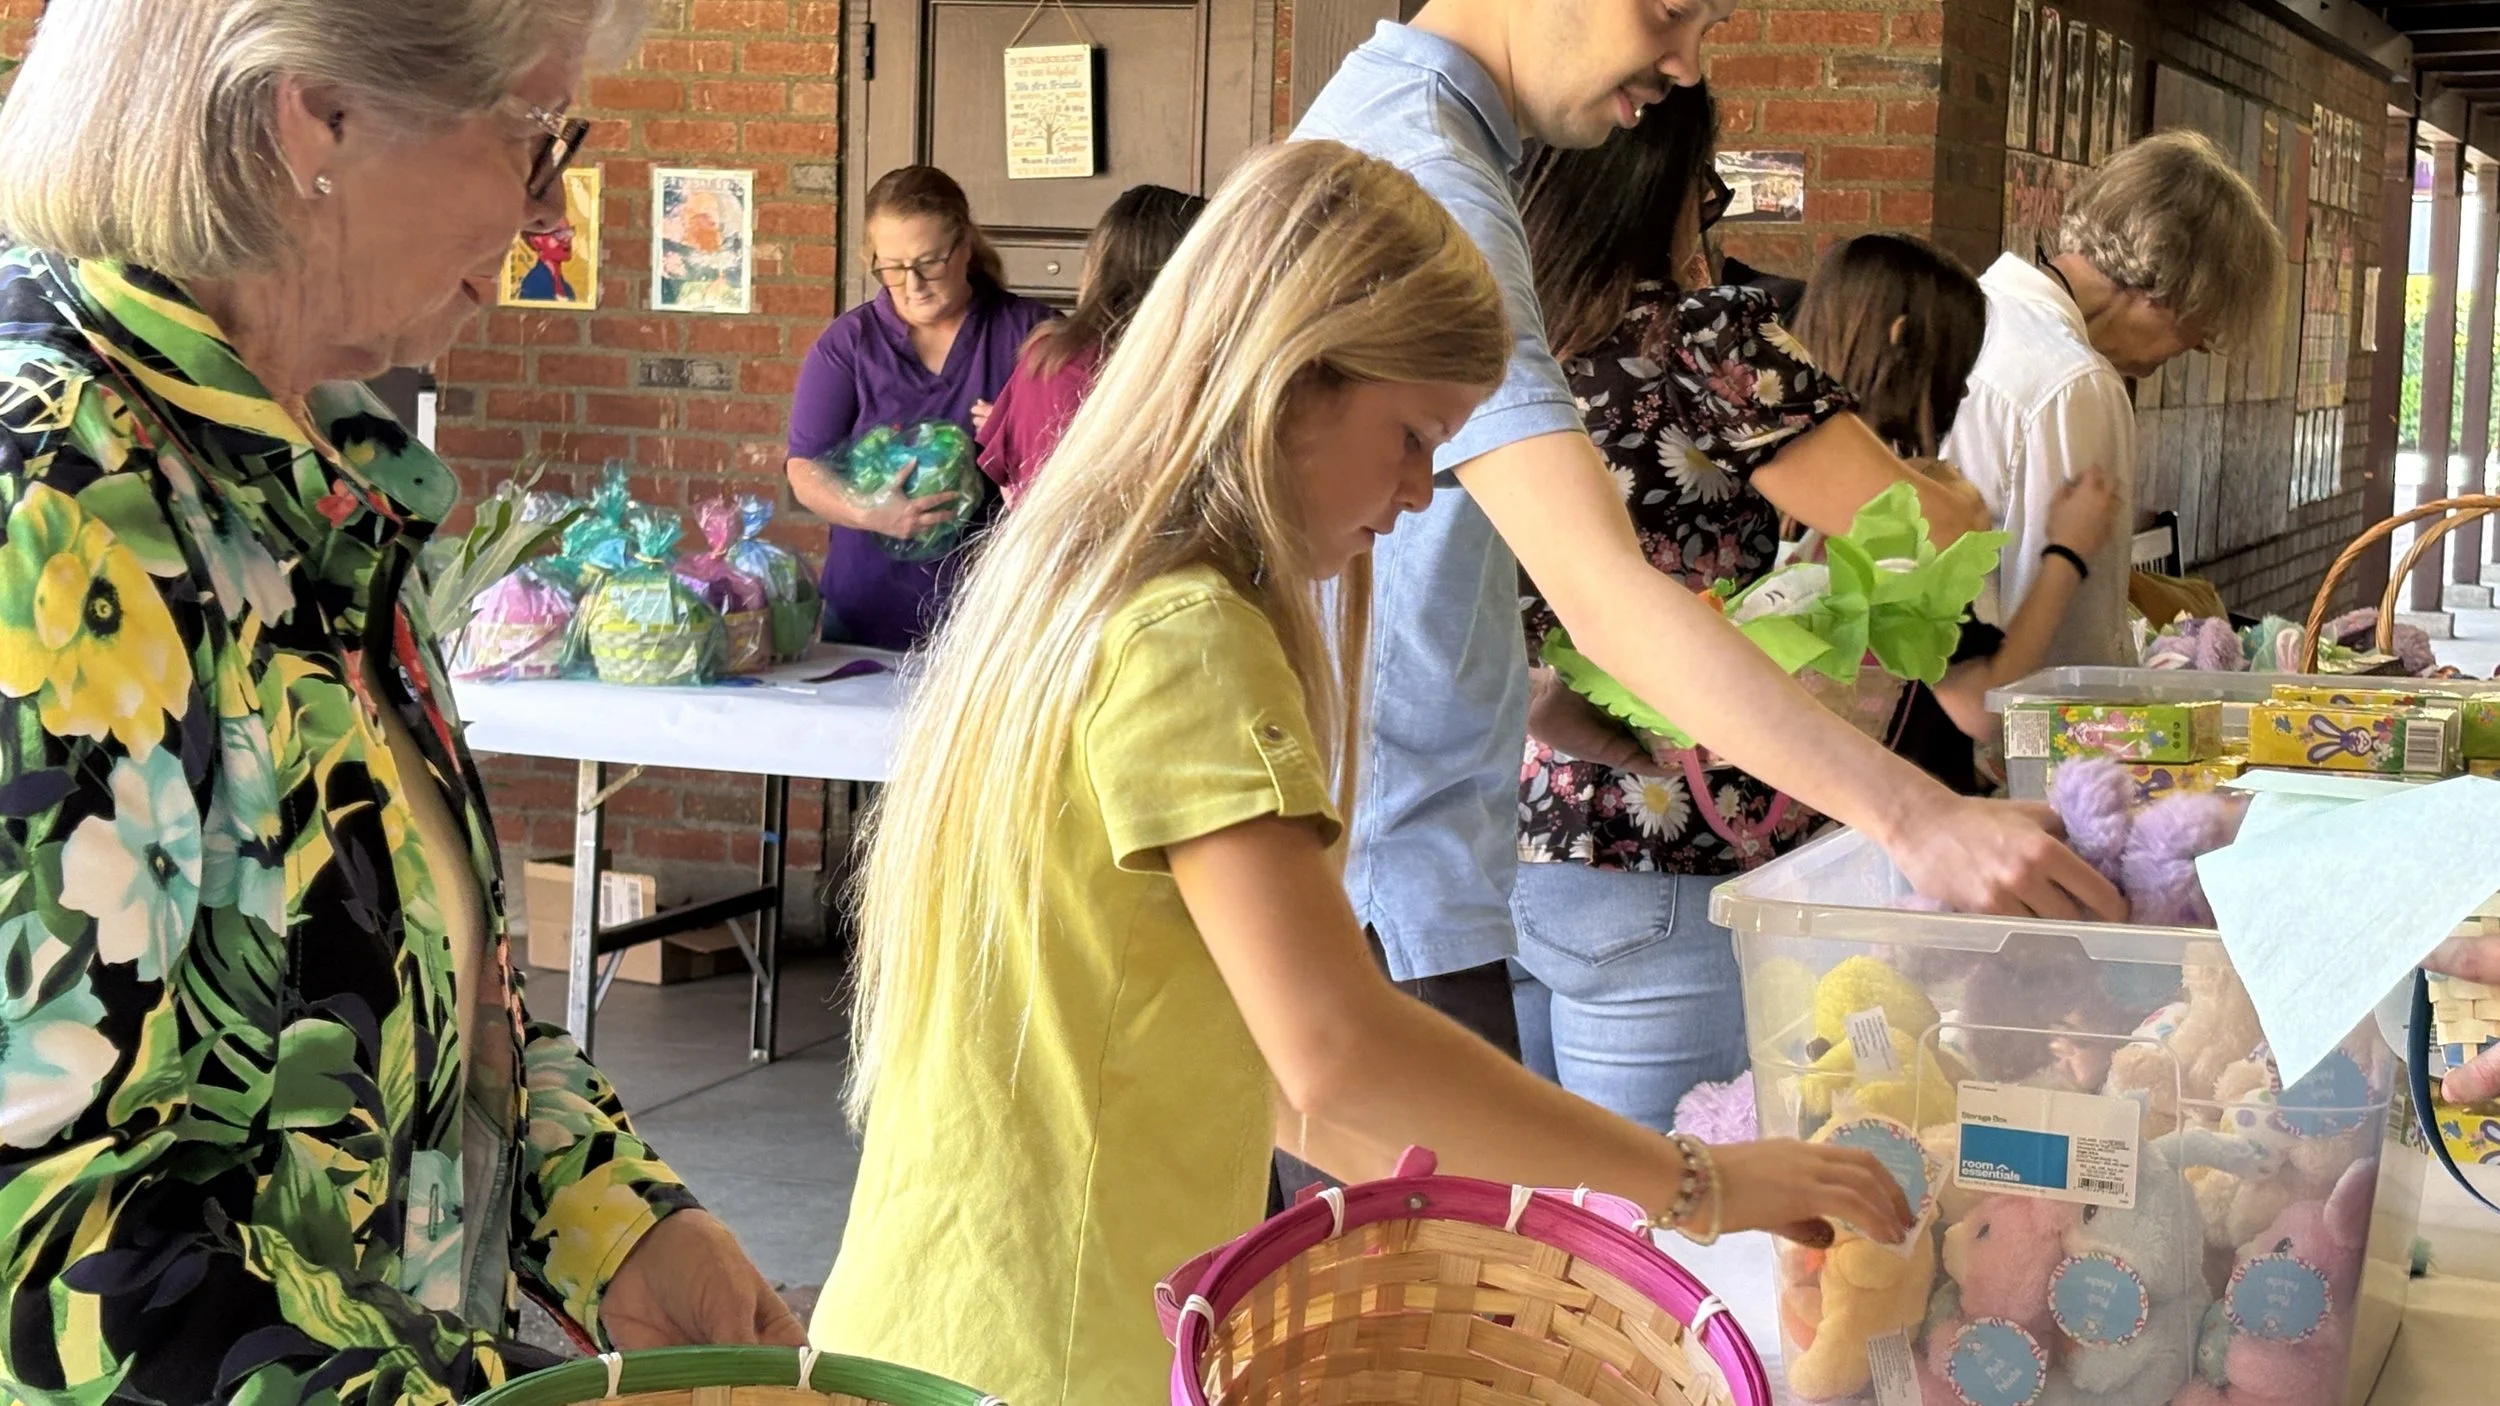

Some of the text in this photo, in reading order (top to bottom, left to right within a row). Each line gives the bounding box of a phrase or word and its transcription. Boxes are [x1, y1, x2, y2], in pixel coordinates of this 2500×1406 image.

[1961, 1111, 2008, 1124] Storage Box
[1962, 1160, 1994, 1171] room
[1961, 1167, 2020, 1181] essentials
